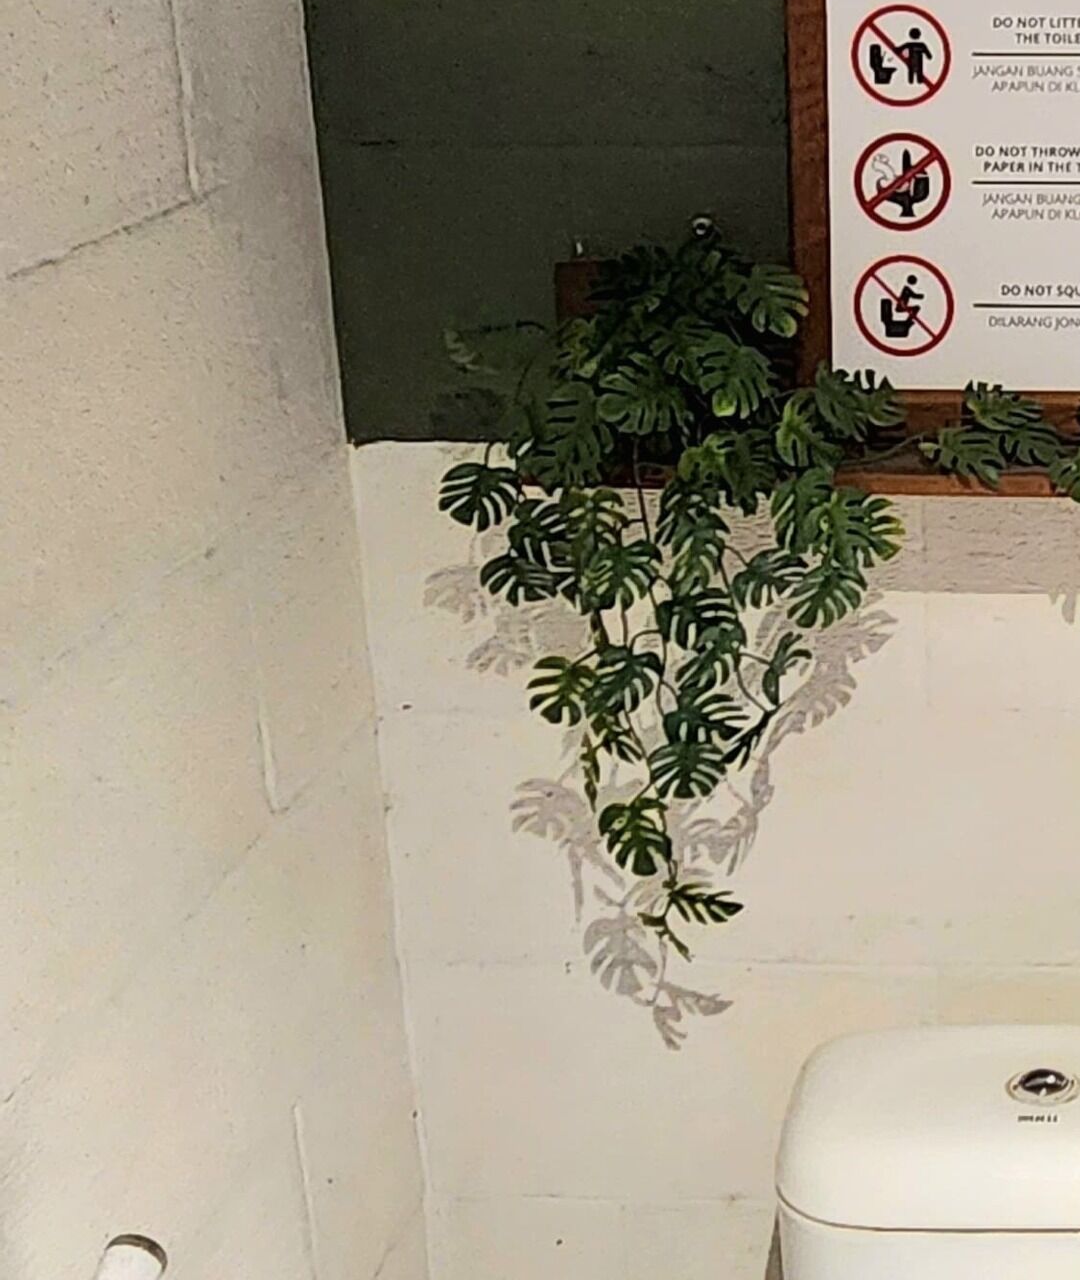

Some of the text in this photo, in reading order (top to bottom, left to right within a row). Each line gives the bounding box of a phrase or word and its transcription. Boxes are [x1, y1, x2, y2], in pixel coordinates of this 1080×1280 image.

[992, 17, 1013, 29] DO
[1016, 17, 1046, 29] NOT
[1015, 32, 1040, 44] THE
[972, 65, 1023, 79] JANGAN
[1027, 65, 1074, 77] BUANG
[991, 81, 1044, 93] APAPUN
[1048, 81, 1062, 93] DI
[975, 146, 995, 158] DO
[999, 146, 1027, 158] NOT
[983, 161, 1025, 173] PAPER
[1029, 161, 1043, 173] IN
[1048, 161, 1071, 173] THE
[982, 193, 1032, 207] JANGAN
[991, 208, 1044, 220] APAPUN
[1048, 209, 1062, 220] DI
[1001, 284, 1021, 296] DO
[1024, 284, 1052, 296] NOT
[988, 316, 1052, 328] DILARANG
